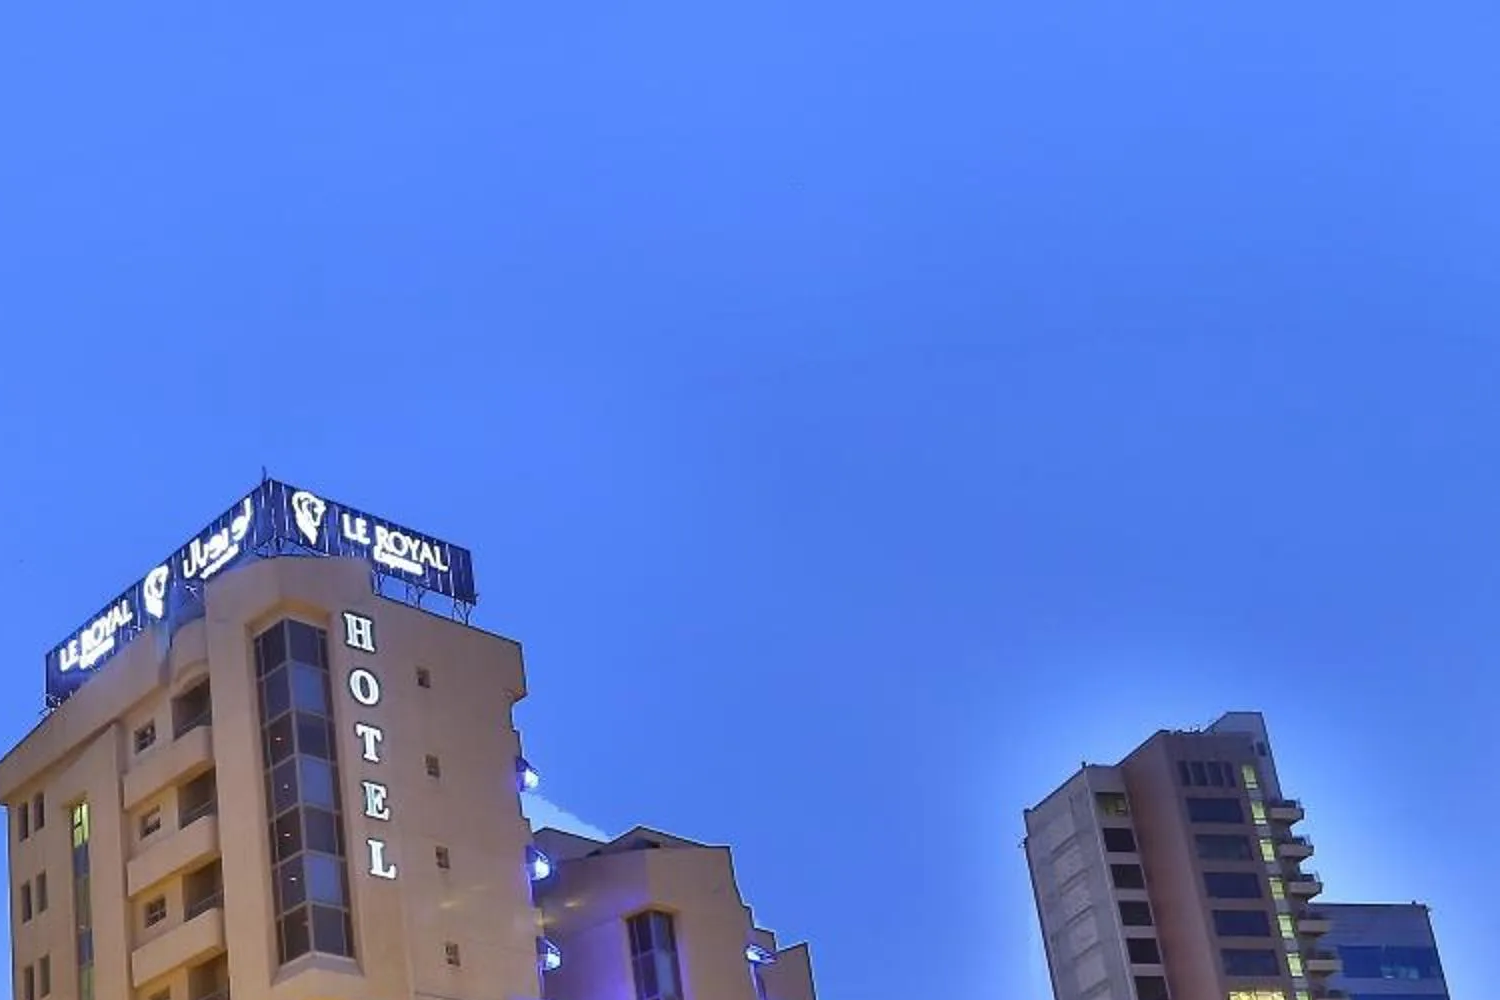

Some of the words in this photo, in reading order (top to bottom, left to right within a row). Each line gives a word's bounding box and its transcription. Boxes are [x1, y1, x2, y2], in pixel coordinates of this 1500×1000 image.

[342, 513, 371, 545] LE
[375, 525, 449, 572] ROYAL
[60, 639, 80, 673] LE
[79, 600, 133, 650] ROYAL
[343, 612, 397, 880] HOTEL
